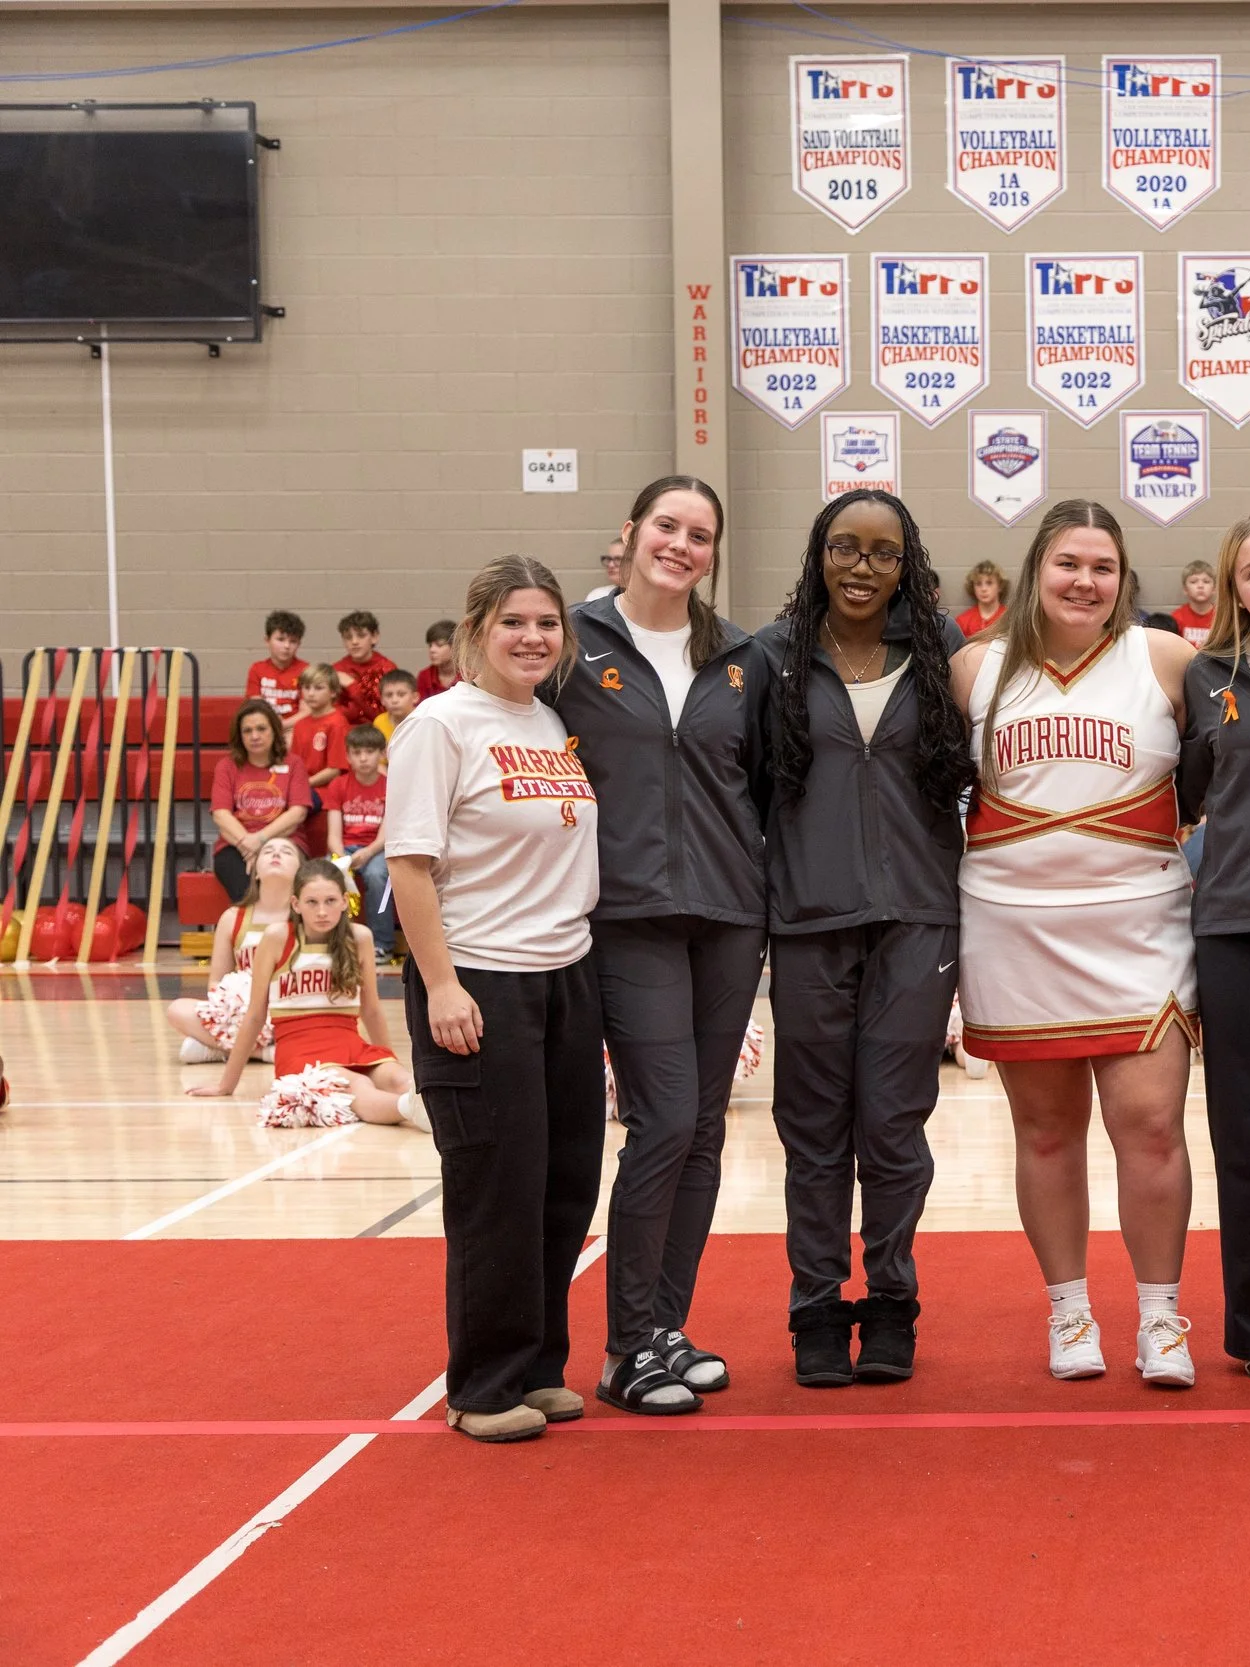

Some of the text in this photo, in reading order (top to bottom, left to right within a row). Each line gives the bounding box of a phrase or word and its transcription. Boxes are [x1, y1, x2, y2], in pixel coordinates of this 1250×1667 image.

[803, 129, 901, 149] SAND VOLLEYBALL
[960, 130, 1057, 149] VOLLEYBALL
[1113, 128, 1210, 148] VOLLEYBALL
[803, 149, 902, 172] CHAMPIONS
[959, 150, 1057, 172] CHAMPION
[1113, 148, 1211, 170] CHAMPION
[1000, 173, 1020, 188] 1A
[1136, 175, 1187, 192] 2020
[828, 179, 877, 200] 2018
[989, 191, 1029, 206] 2018
[1153, 198, 1172, 209] 1A
[741, 327, 840, 347] VOLLEYBALL
[881, 325, 979, 345] BASKETBALL
[1036, 325, 1135, 345] BASKETBALL
[686, 284, 712, 445] WARRIORS
[742, 348, 840, 369] CHAMPION
[881, 346, 980, 367] CHAMPIONS
[1037, 345, 1135, 367] CHAMPIONS
[767, 374, 817, 391] 2022
[905, 372, 955, 389] 2022
[1061, 372, 1112, 389] 2022
[784, 396, 803, 409] 1A
[922, 394, 941, 407] 1A
[1078, 394, 1097, 407] 1A
[1161, 443, 1198, 459] TENNIS
[528, 462, 572, 472] GRADE
[547, 474, 554, 483] 4
[828, 480, 893, 495] CHAMPION
[1134, 483, 1197, 498] RUNNER-UP
[993, 714, 1133, 773] WARRIORS
[637, 1350, 654, 1362] NIKE
